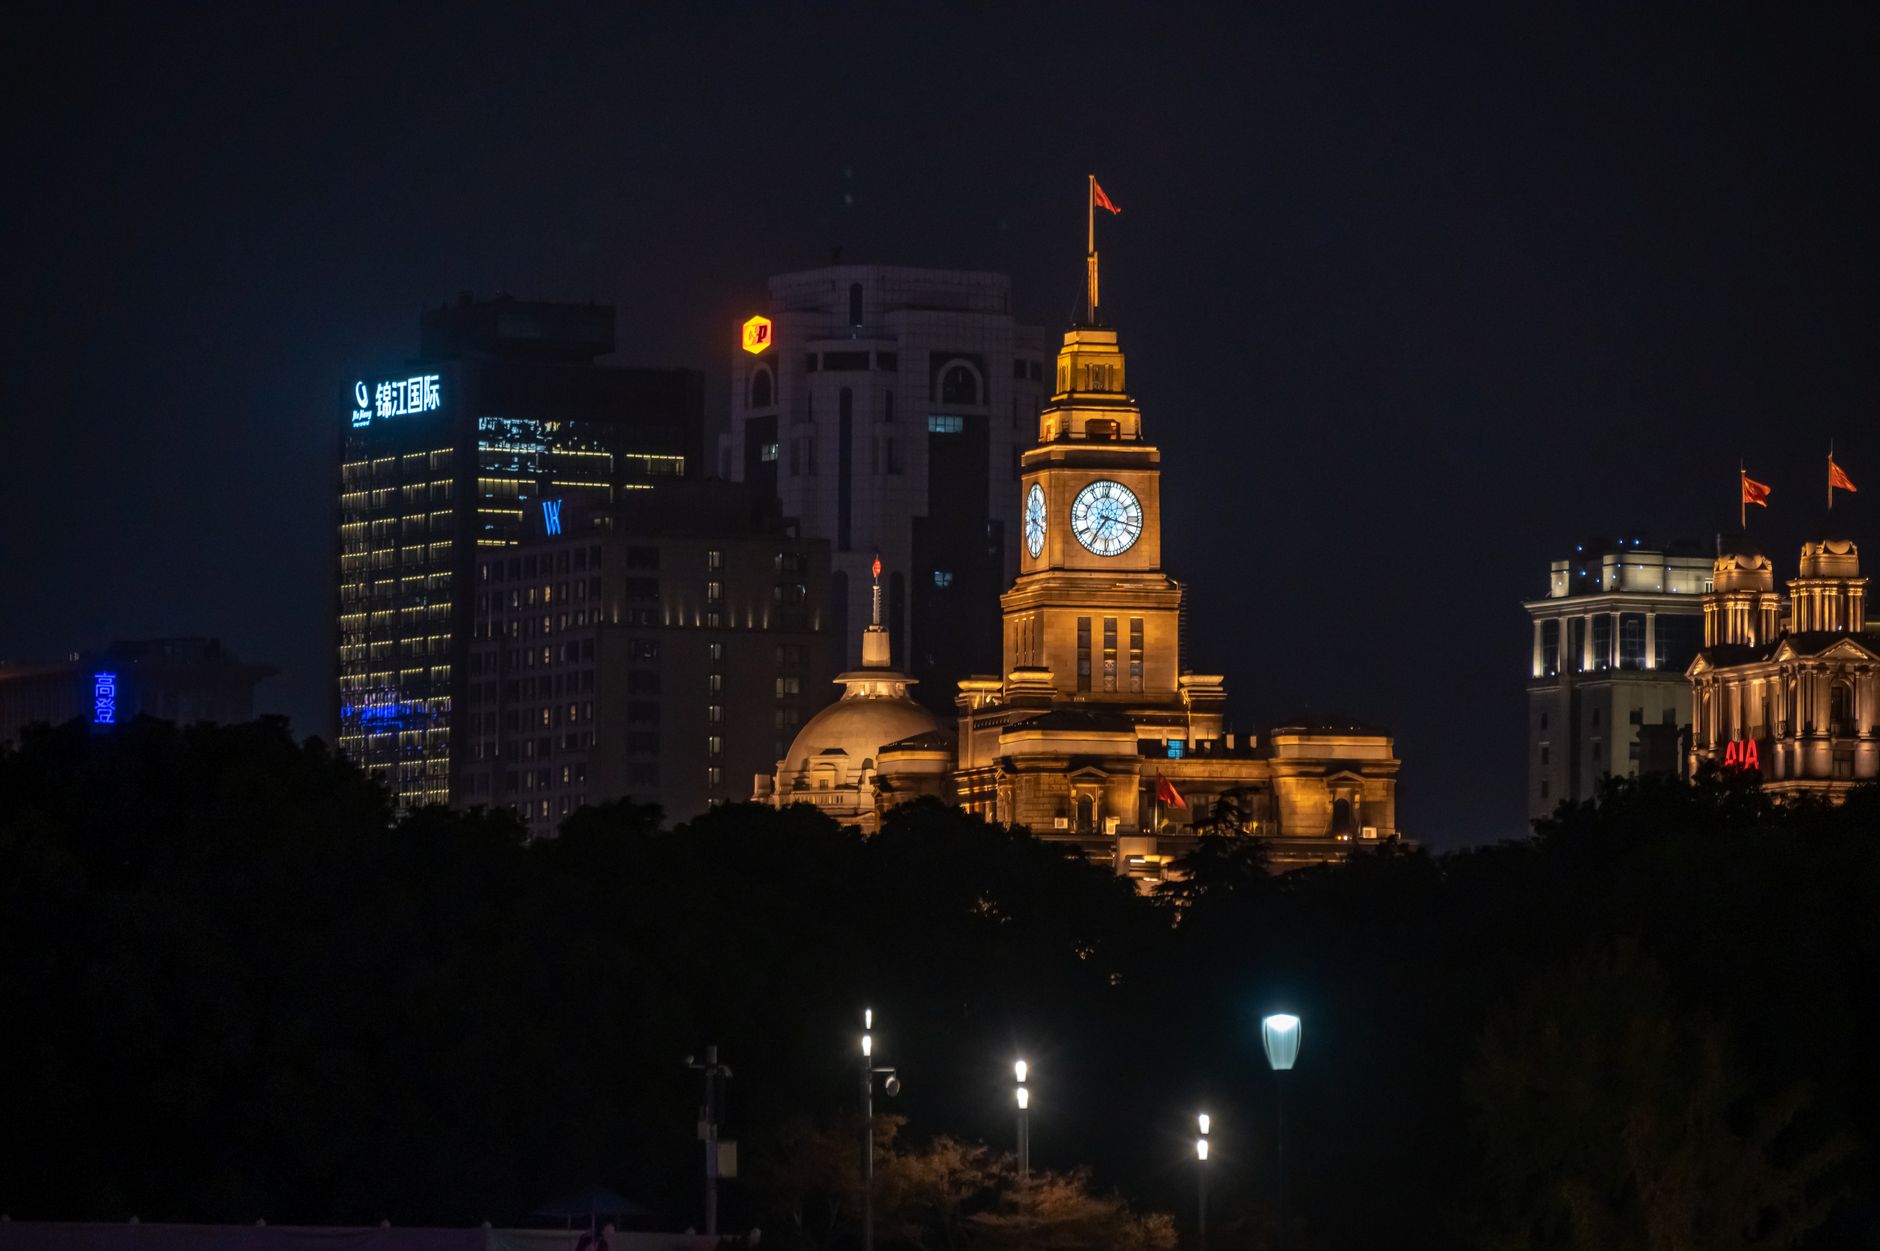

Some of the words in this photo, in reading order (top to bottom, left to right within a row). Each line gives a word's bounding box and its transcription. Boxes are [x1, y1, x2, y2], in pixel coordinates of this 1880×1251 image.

[375, 374, 440, 418] 锦江国际
[1724, 738, 1760, 769] AIA
